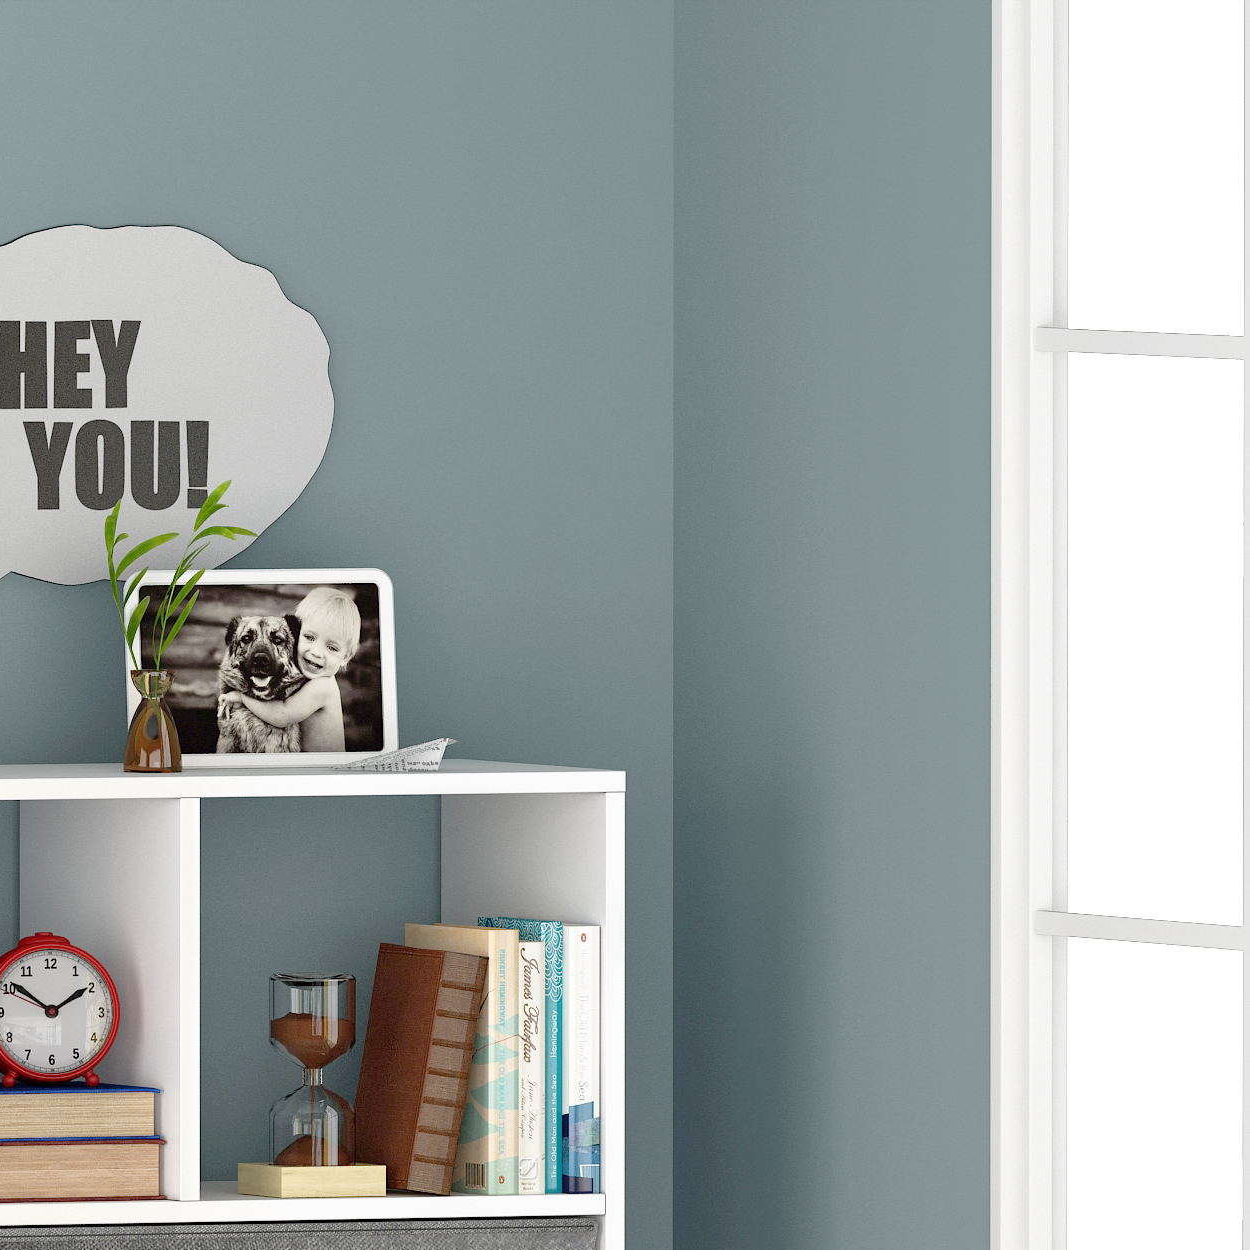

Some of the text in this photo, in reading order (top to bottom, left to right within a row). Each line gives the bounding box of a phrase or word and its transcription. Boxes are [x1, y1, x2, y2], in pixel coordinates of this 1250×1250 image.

[22, 419, 209, 511] YOU!
[44, 958, 58, 970] 12
[20, 966, 33, 977] 11
[72, 966, 79, 977] 1
[3, 983, 16, 995] 10
[88, 982, 95, 993] 2
[518, 947, 540, 1063] James Fairfax
[98, 1007, 105, 1018] 3
[6, 1032, 13, 1043] 8
[90, 1032, 98, 1043] 4
[550, 1010, 558, 1058] Hemingway
[579, 993, 589, 1101] The Old Man & the Sea
[24, 1049, 32, 1061] 7
[72, 1048, 80, 1059] 5
[48, 1054, 56, 1066] 6
[527, 1075, 538, 1140] Jane Austen
